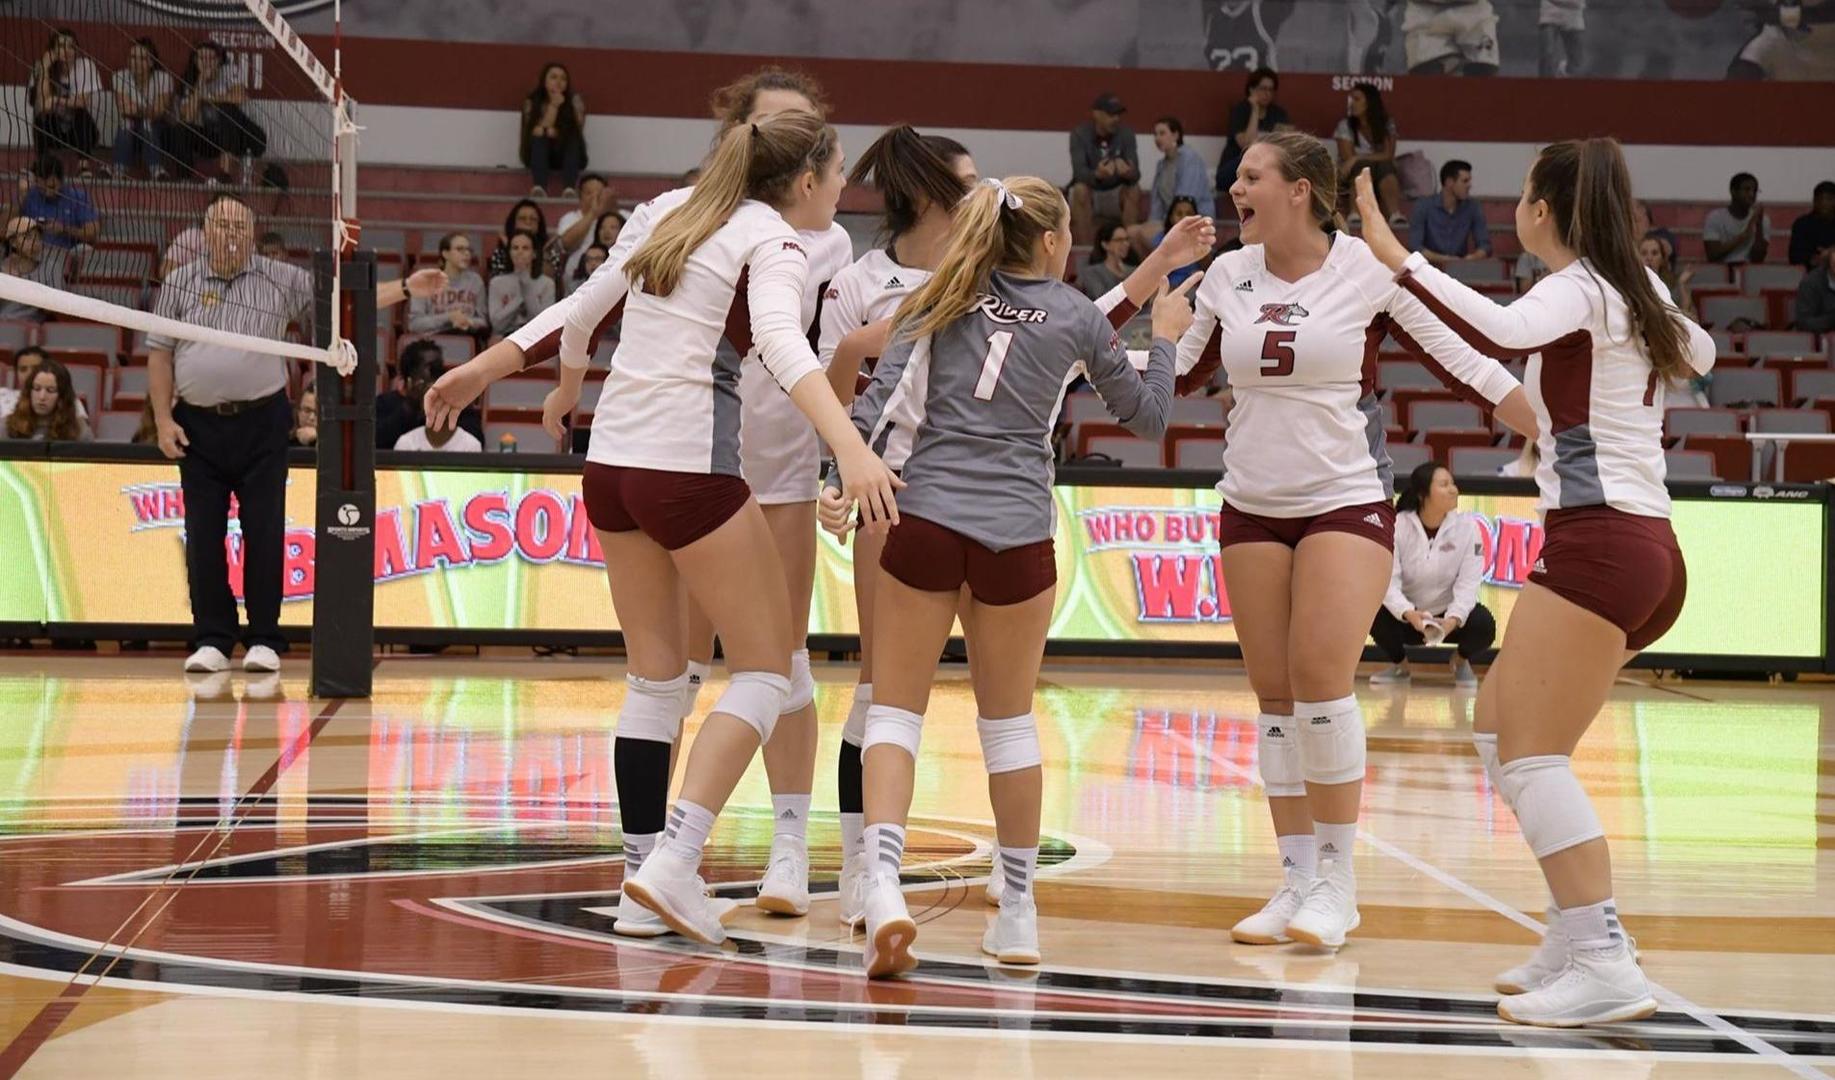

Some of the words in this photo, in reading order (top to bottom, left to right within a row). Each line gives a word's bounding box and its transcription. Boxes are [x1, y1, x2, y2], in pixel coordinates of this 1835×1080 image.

[973, 329, 1016, 402] 1
[1260, 330, 1297, 377] 5
[130, 489, 186, 523] WH
[1086, 513, 1156, 544] WHO
[1165, 513, 1221, 544] BUT
